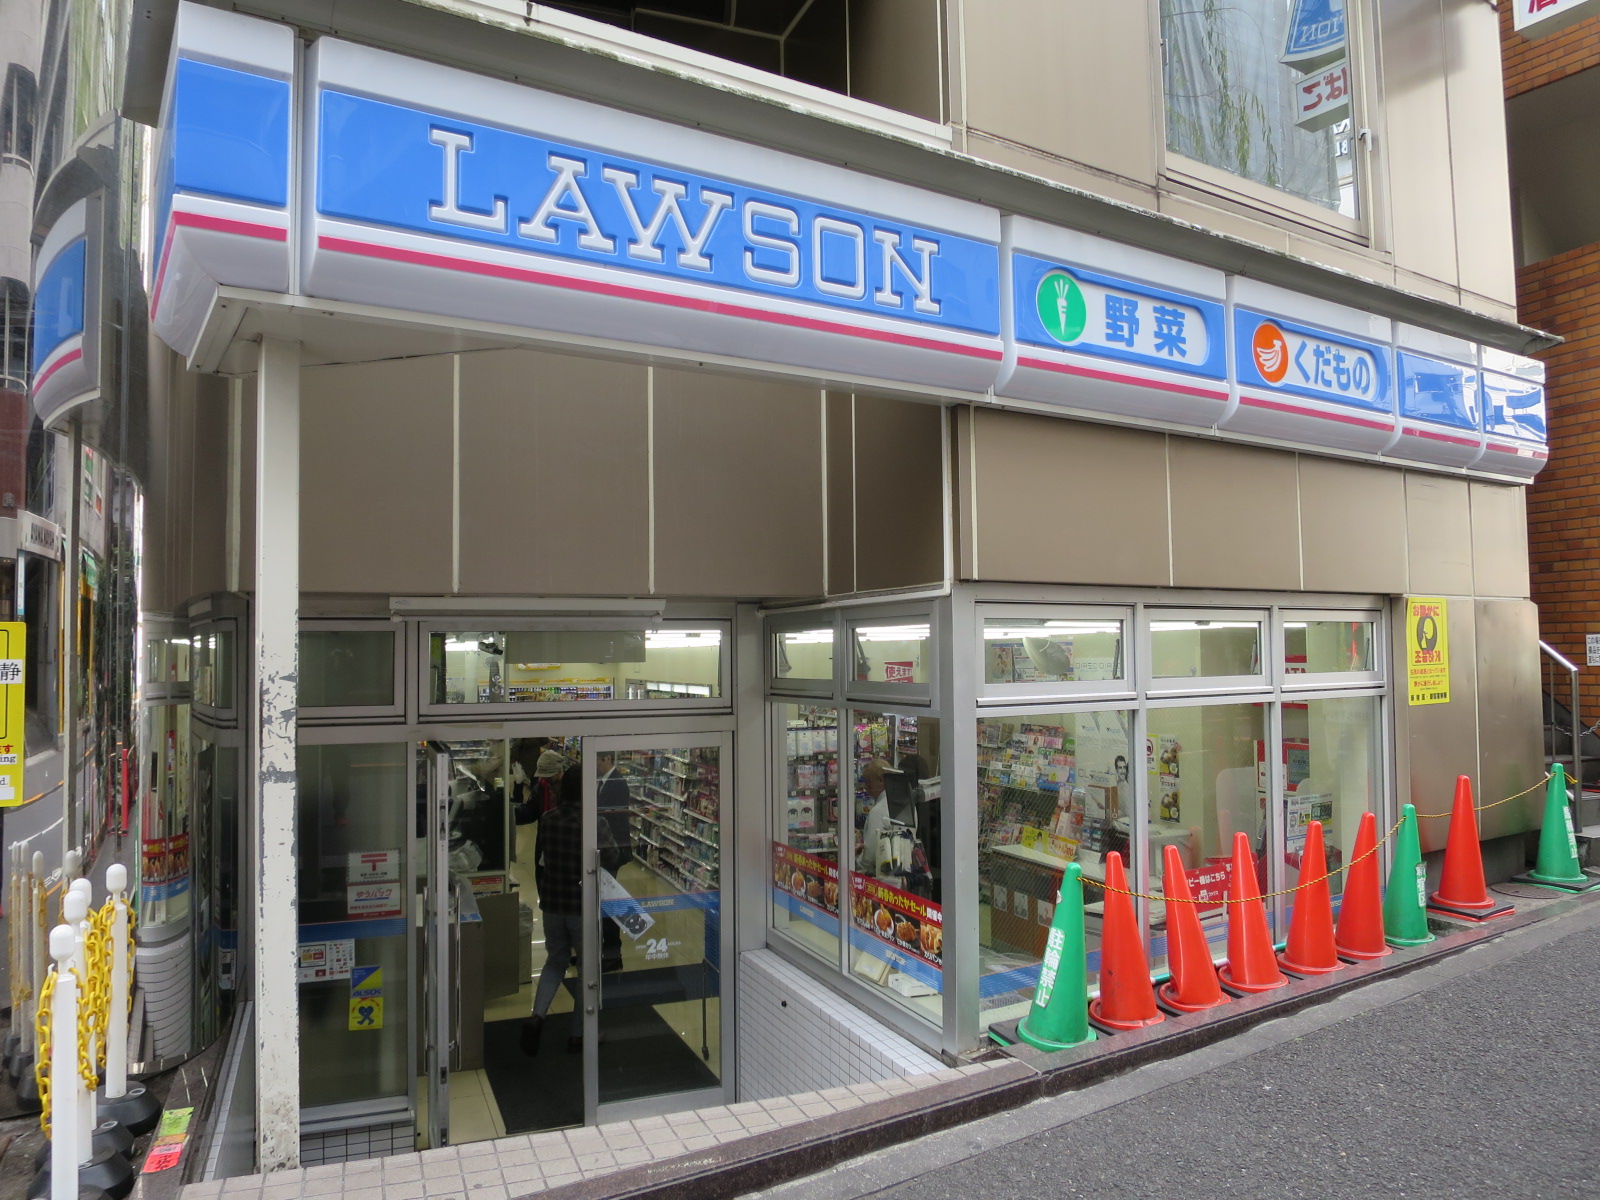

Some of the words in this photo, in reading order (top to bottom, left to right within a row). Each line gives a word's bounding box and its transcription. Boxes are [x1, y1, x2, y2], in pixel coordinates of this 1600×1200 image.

[427, 126, 941, 316] LAWSON
[1104, 293, 1188, 359] 野菜
[1295, 340, 1372, 394] くだもの
[0, 744, 13, 754] す
[646, 938, 668, 953] 24
[1036, 927, 1064, 1008] 駐輪禁止
